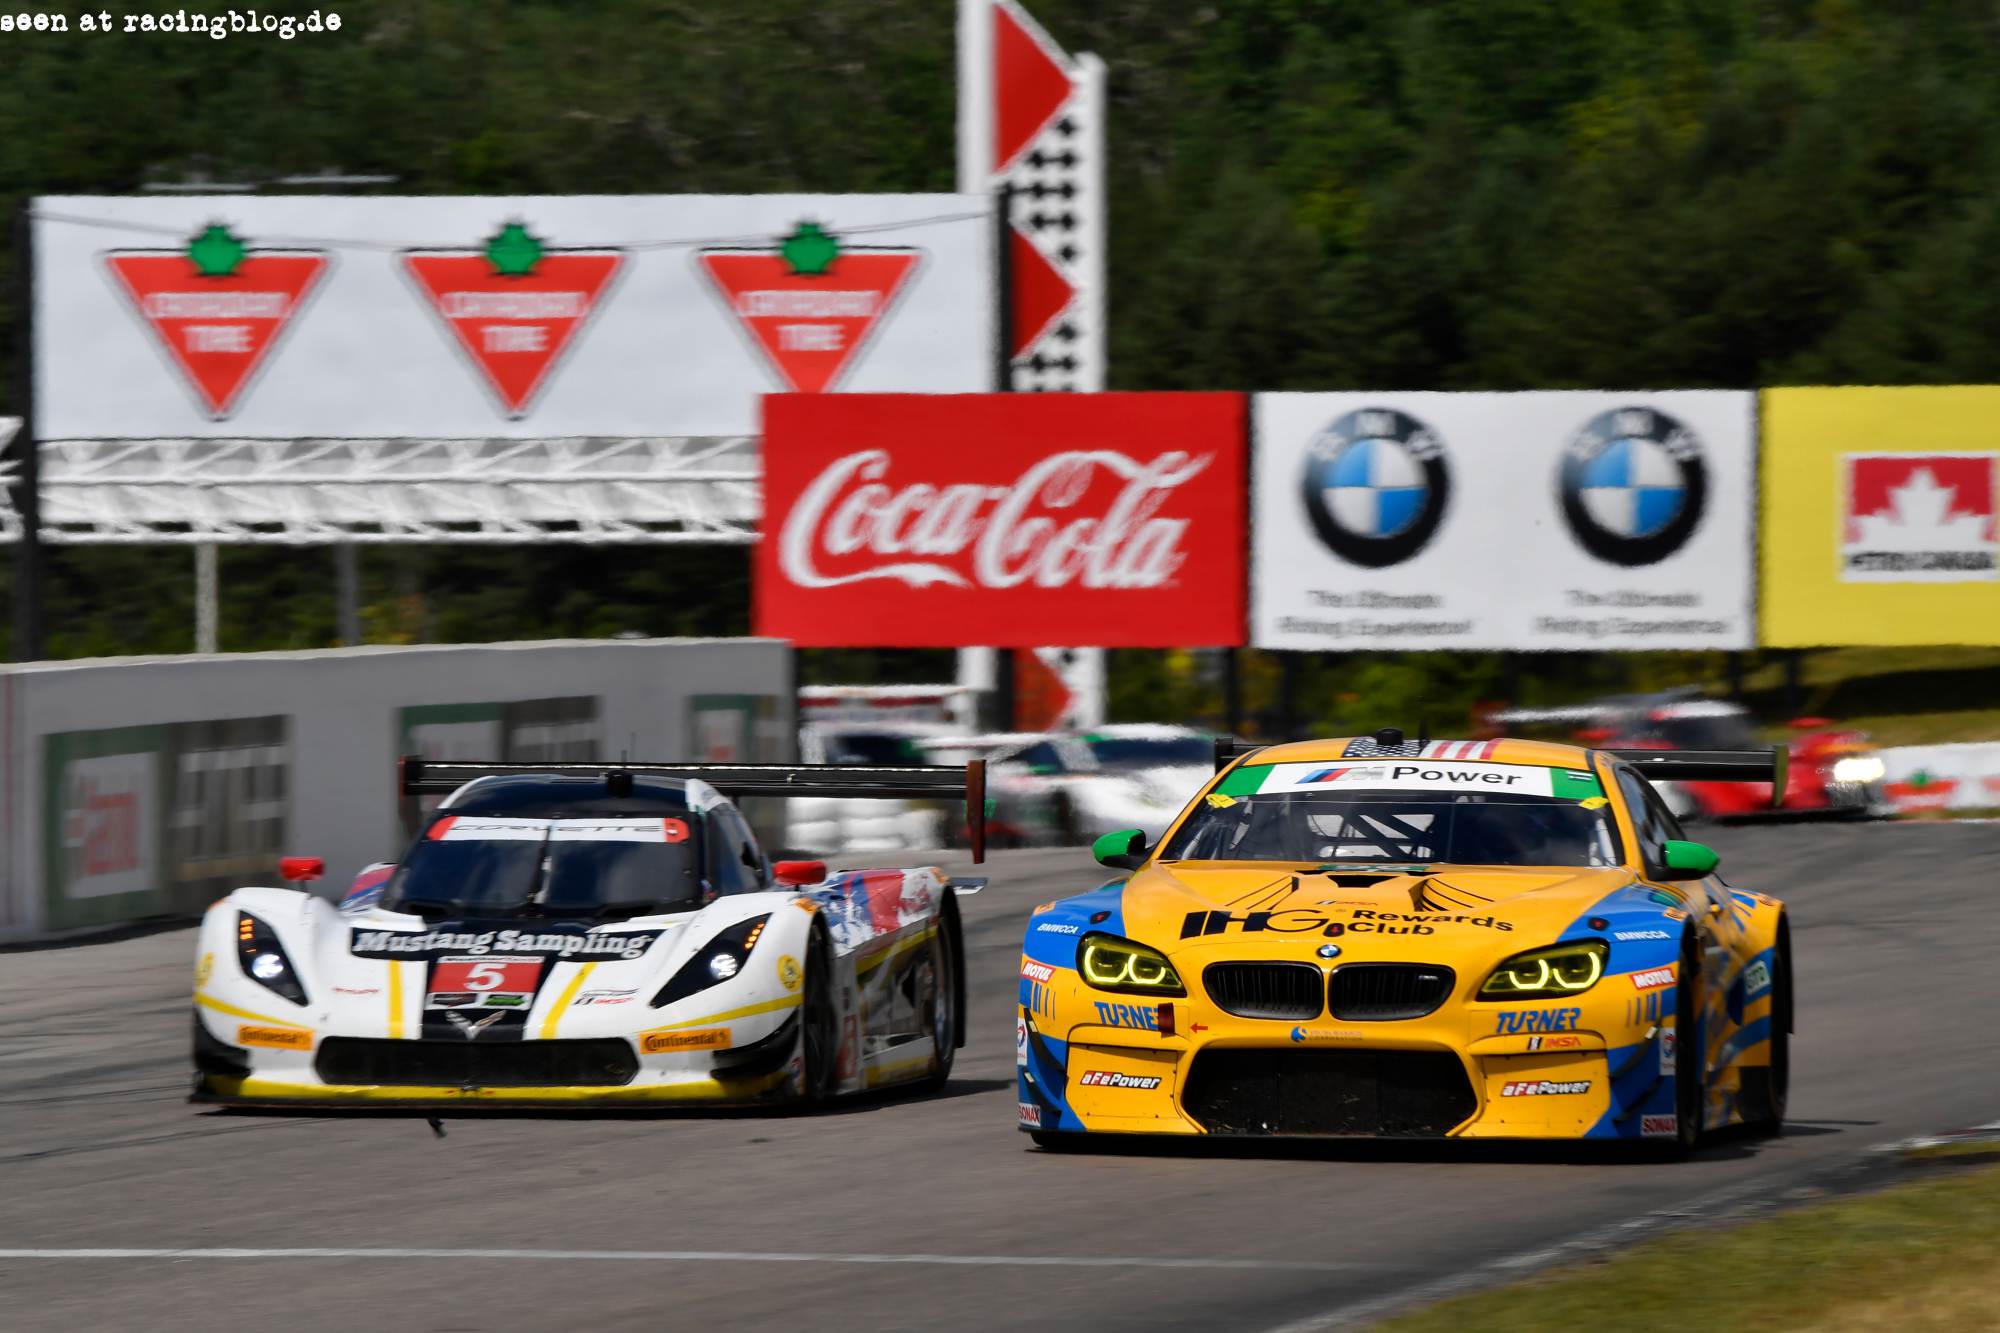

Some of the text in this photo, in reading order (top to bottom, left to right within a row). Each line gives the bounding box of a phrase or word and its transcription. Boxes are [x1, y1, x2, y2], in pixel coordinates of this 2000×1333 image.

[1391, 766, 1523, 785] Power
[1180, 909, 1330, 940] IHG
[1346, 921, 1435, 936] Club
[1352, 909, 1515, 932] Rewards
[356, 929, 654, 959] Mustang Sampling
[464, 963, 505, 991] 5
[1022, 962, 1053, 981] MOTUL
[1632, 968, 1677, 988] MOTUL
[1094, 1001, 1159, 1030] TURNE
[1497, 1007, 1581, 1033] TURNER
[644, 1030, 717, 1051] Continental
